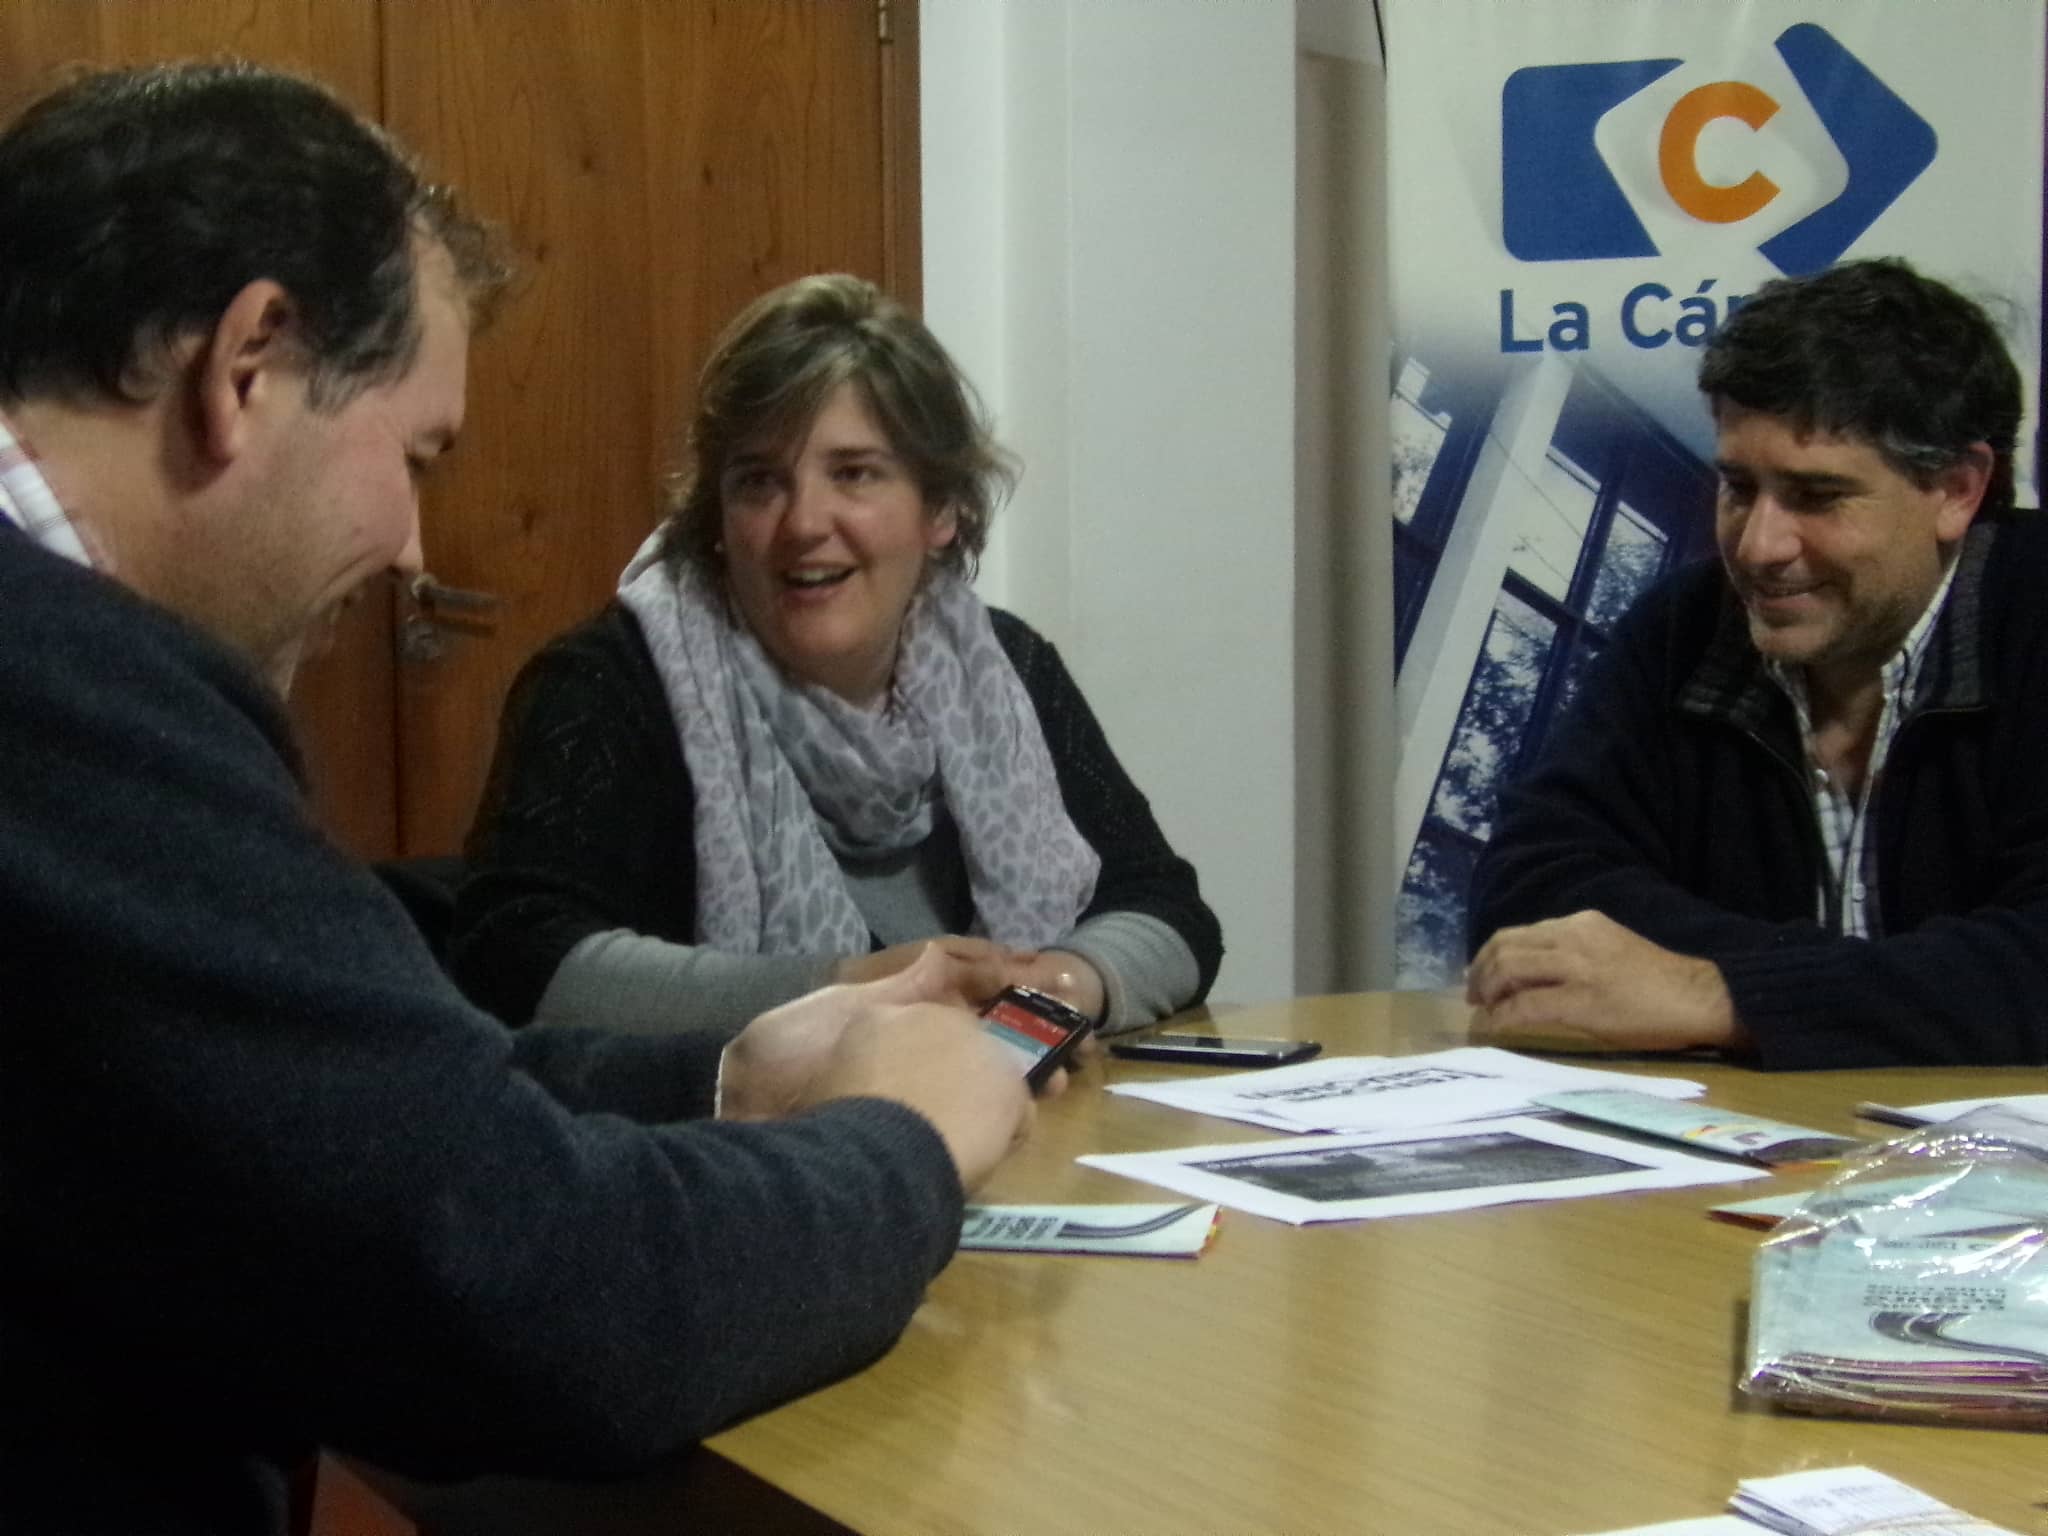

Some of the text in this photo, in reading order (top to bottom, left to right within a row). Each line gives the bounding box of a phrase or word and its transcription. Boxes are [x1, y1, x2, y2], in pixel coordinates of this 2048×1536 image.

[1658, 81, 1781, 224] C
[1500, 279, 1753, 353] La Cá
